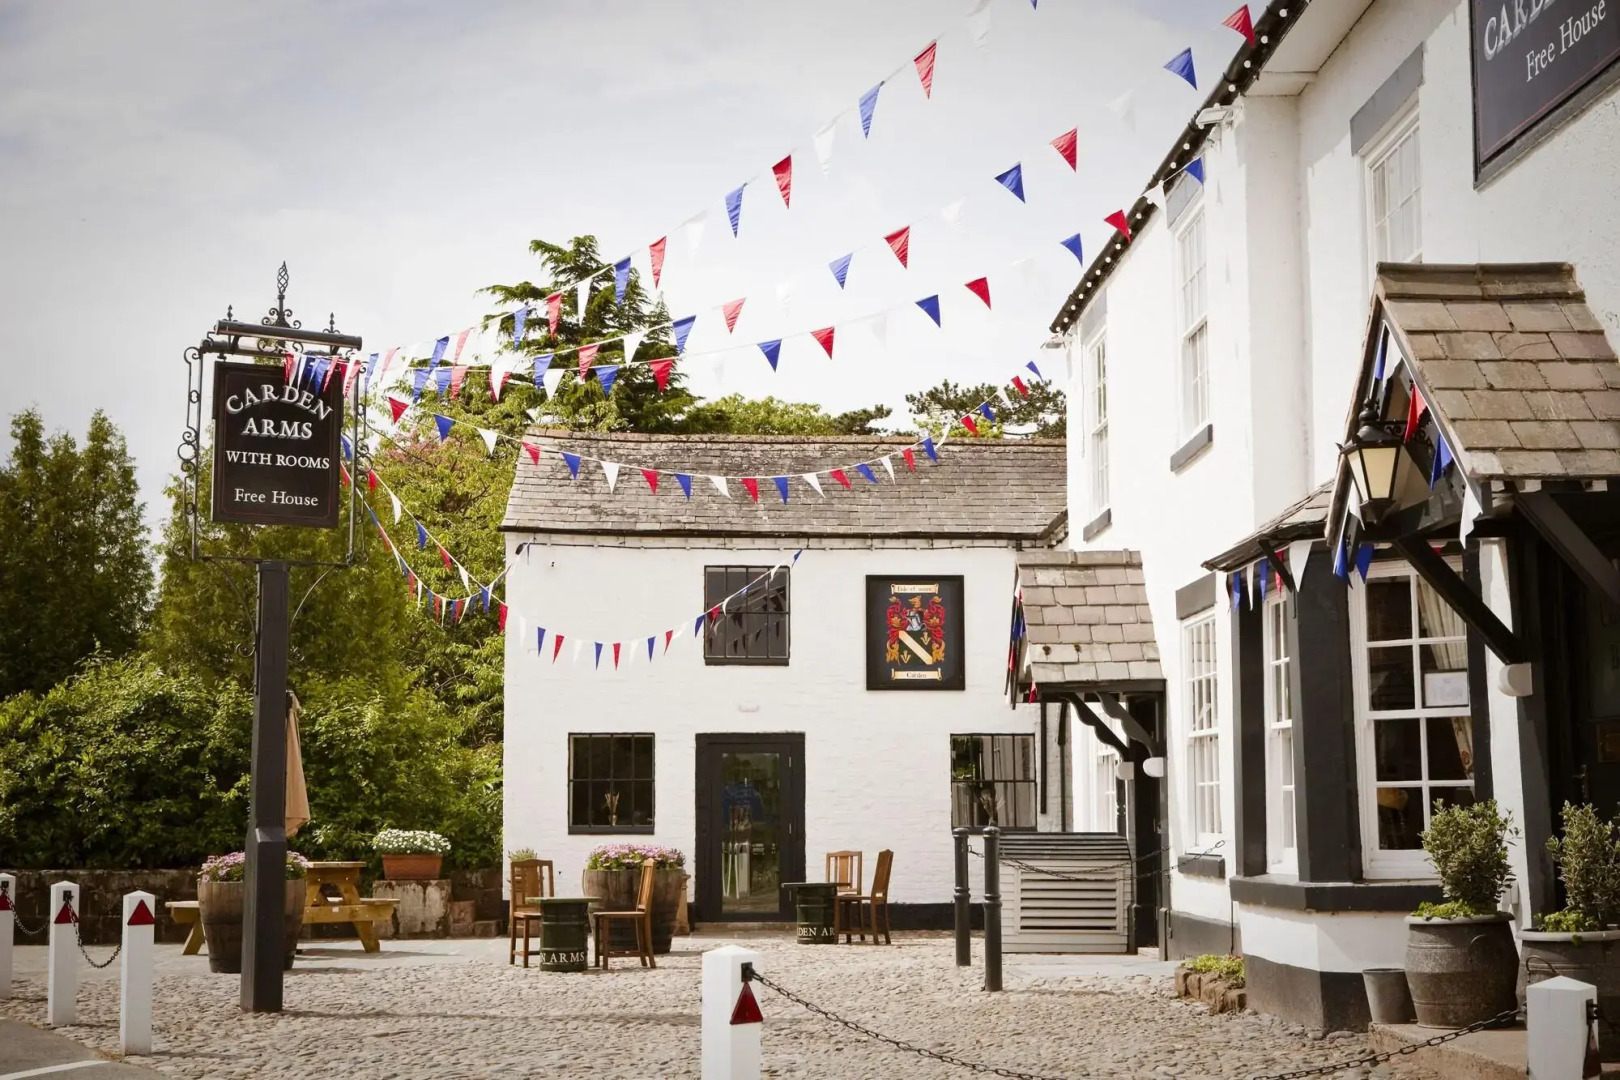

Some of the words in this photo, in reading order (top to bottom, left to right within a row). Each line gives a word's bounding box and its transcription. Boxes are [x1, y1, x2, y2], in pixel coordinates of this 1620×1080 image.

[1484, 0, 1556, 61] CAR
[1526, 42, 1555, 82] Free
[1559, 0, 1606, 54] House
[226, 384, 333, 420] CARDEN
[241, 417, 313, 440] ARMS
[226, 450, 272, 465] WITH
[275, 454, 330, 469] ROOMS
[234, 488, 266, 502] Free
[271, 491, 319, 506] House
[797, 927, 817, 937] DEN
[550, 951, 585, 963] ARMS
